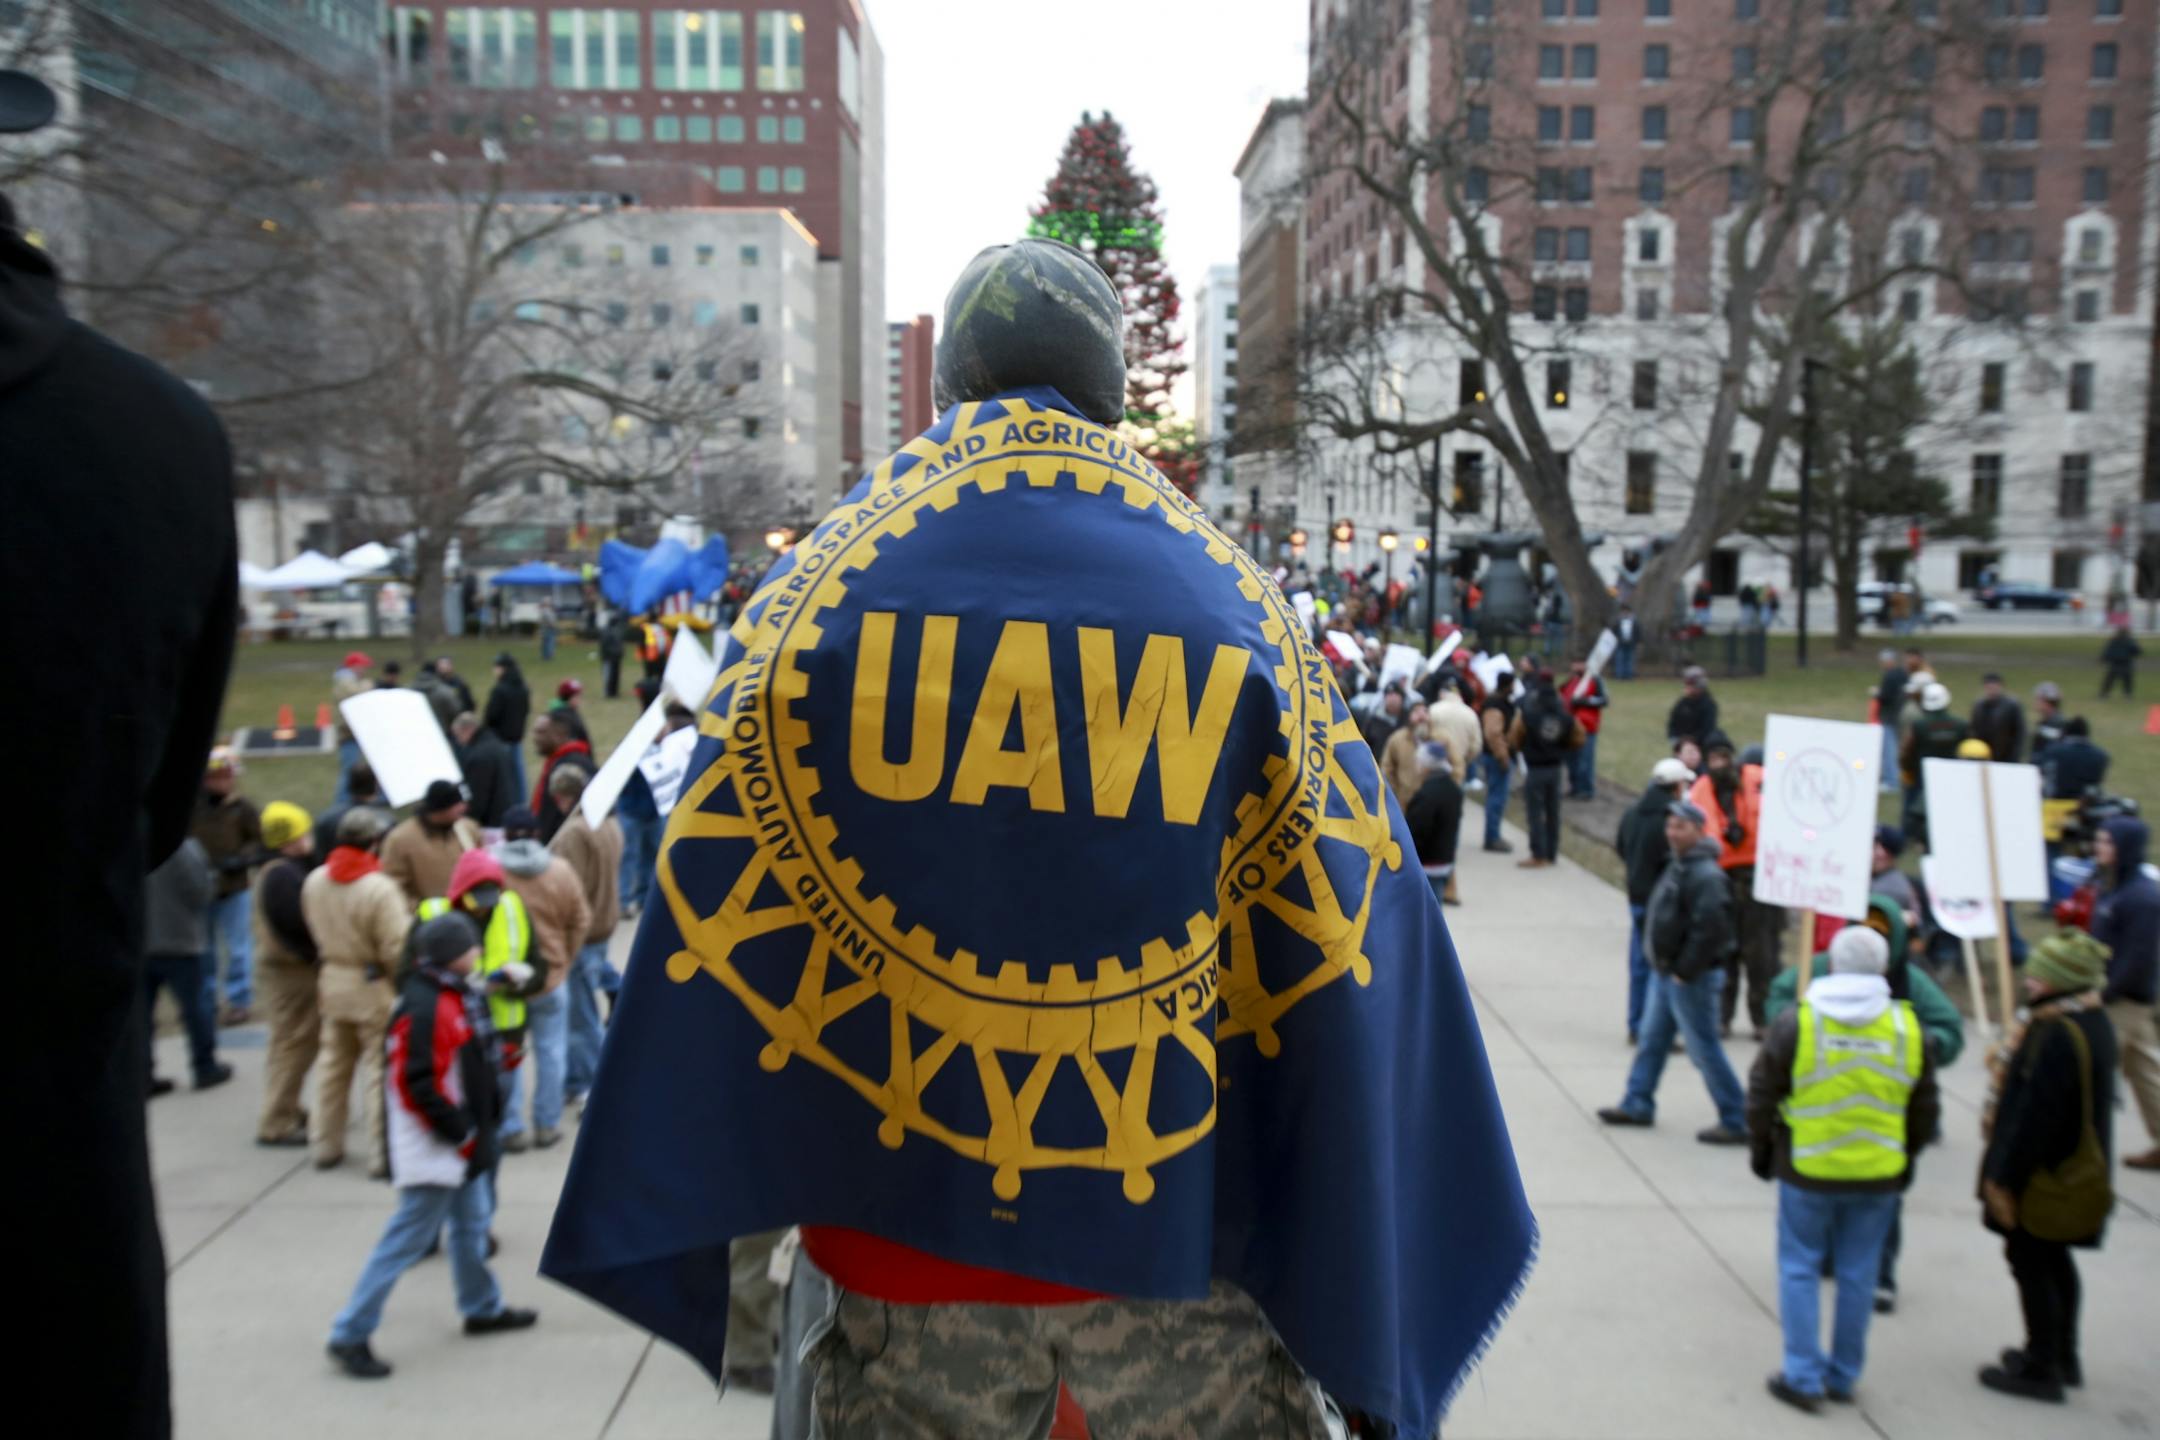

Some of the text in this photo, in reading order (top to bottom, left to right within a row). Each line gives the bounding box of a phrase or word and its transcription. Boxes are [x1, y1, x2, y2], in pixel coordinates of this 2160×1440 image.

[923, 435, 986, 482] AND
[767, 483, 907, 630] AEROSPACE
[733, 647, 802, 862] AUTOMOBILE,
[849, 611, 1251, 826] UAW
[1266, 720, 1328, 866] WORKERS
[796, 873, 885, 976] UNITED
[1227, 863, 1266, 904] OF
[1154, 960, 1218, 1021] RICA
